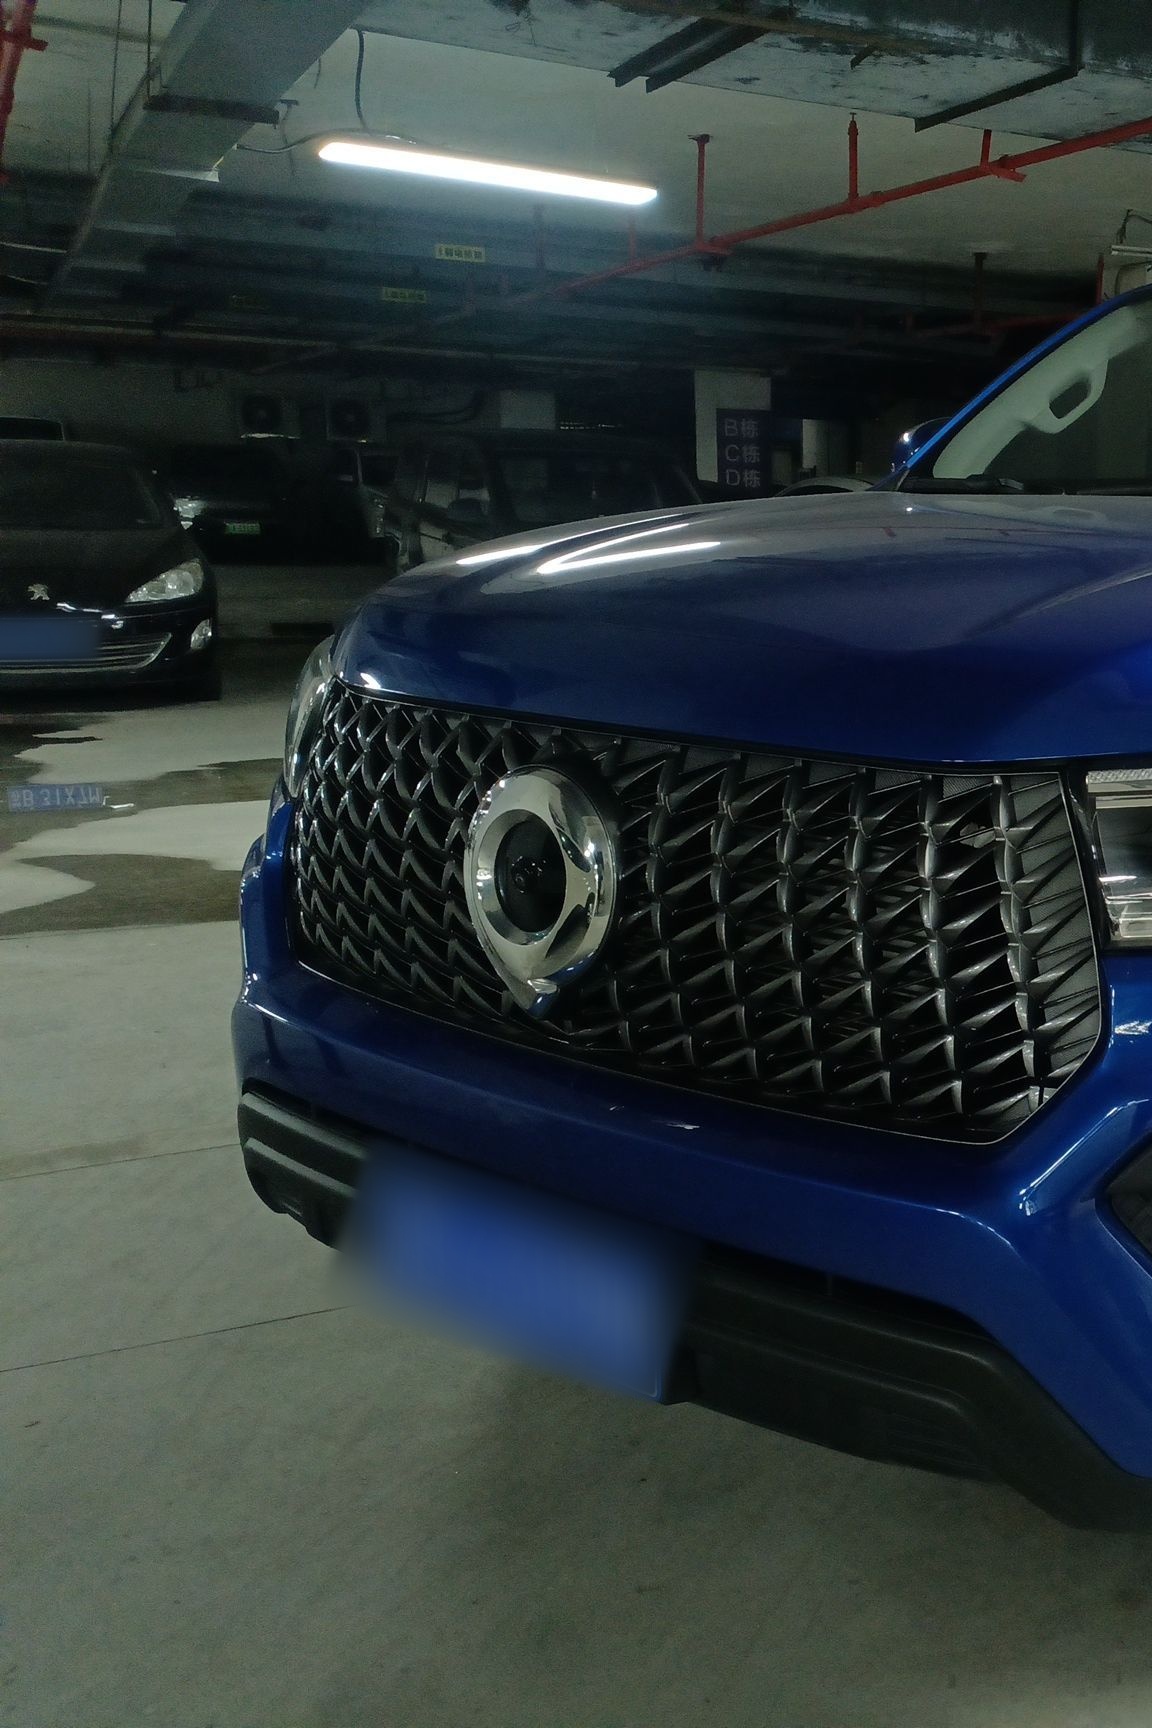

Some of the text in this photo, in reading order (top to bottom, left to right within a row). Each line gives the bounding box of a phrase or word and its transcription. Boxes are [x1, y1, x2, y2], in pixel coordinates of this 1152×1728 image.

[724, 418, 760, 438] B栋
[725, 443, 760, 463] C栋
[725, 468, 761, 488] D栋
